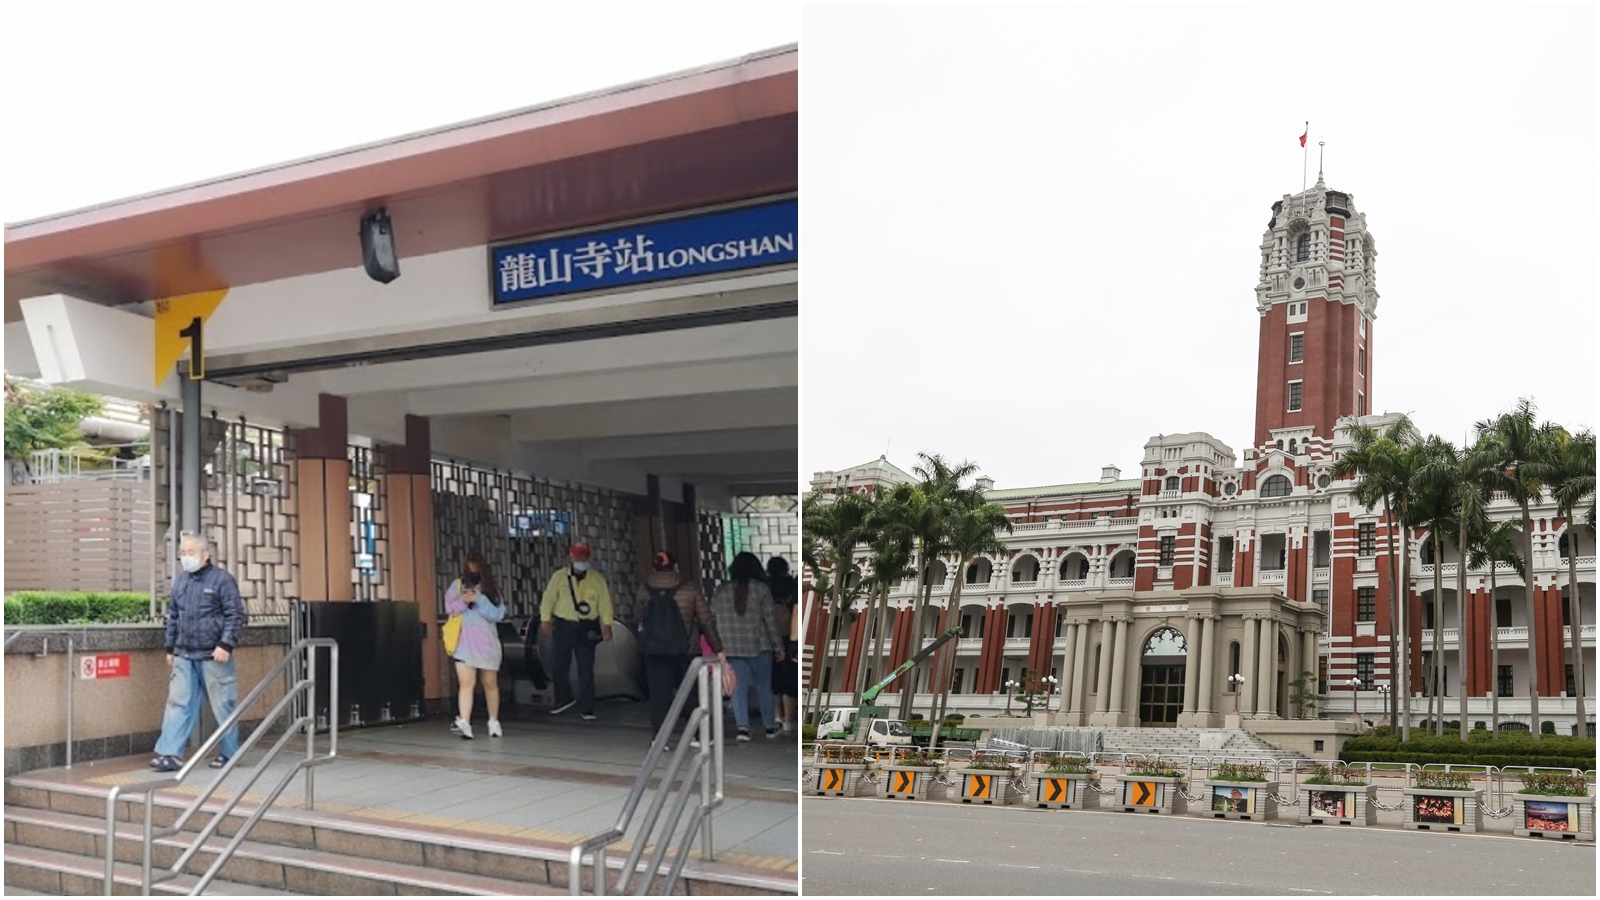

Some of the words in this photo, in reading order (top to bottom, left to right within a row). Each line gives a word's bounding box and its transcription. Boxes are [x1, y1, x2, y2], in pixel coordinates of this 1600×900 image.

[500, 234, 655, 292] 龍山寺站
[657, 233, 794, 270] LONGSHAN
[179, 316, 203, 377] 1
